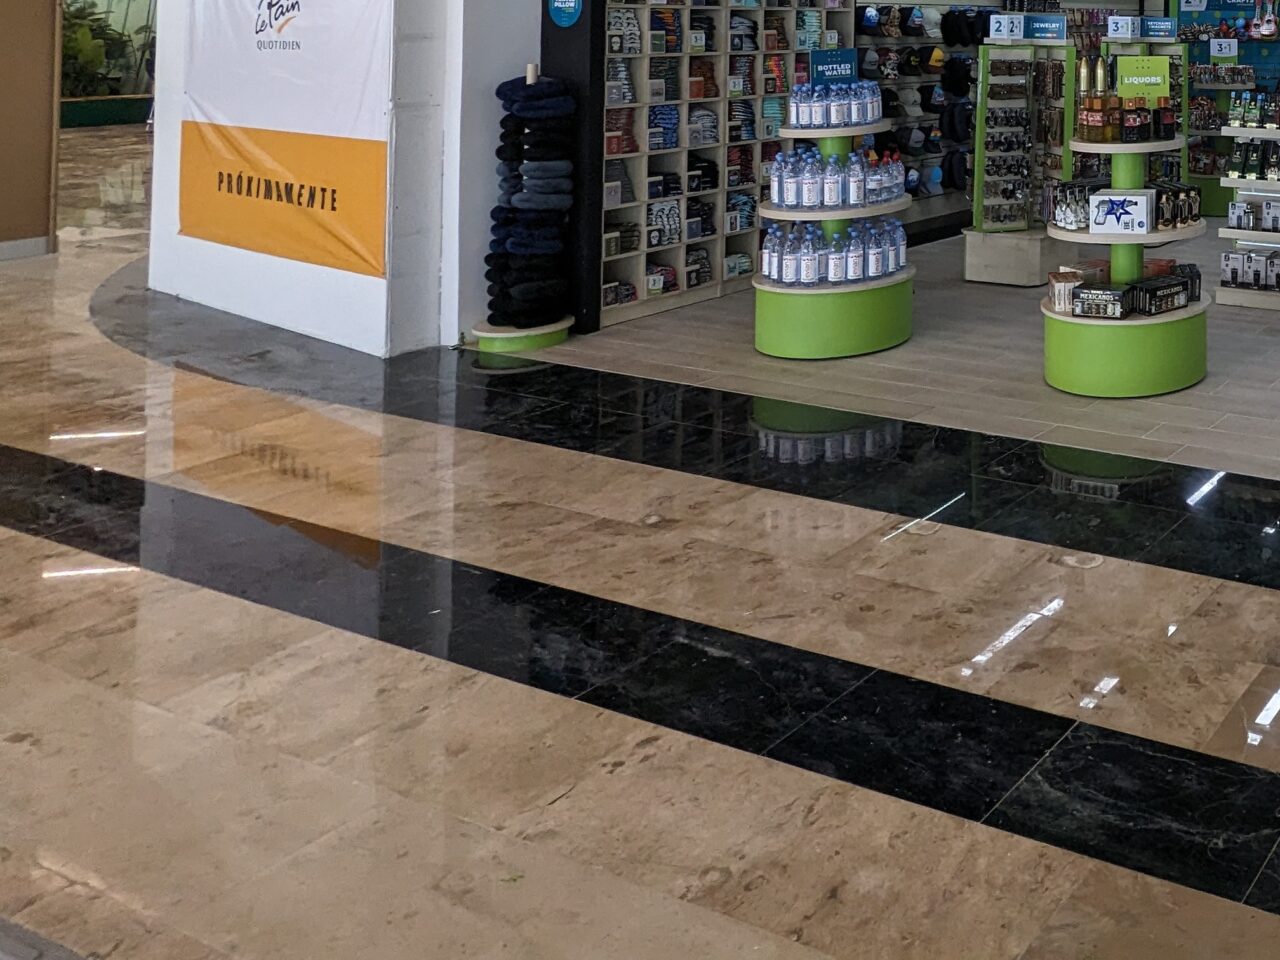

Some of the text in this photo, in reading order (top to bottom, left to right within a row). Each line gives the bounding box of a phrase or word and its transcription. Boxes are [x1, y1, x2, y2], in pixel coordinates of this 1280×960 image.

[255, 13, 268, 35] Le
[256, 40, 301, 51] QUOTIDIEN
[817, 63, 851, 71] BOTTLED
[1124, 76, 1162, 84] LIQUORS
[217, 170, 337, 212] PRÓXIMAMENTE
[1080, 292, 1114, 301] MEXICANOS
